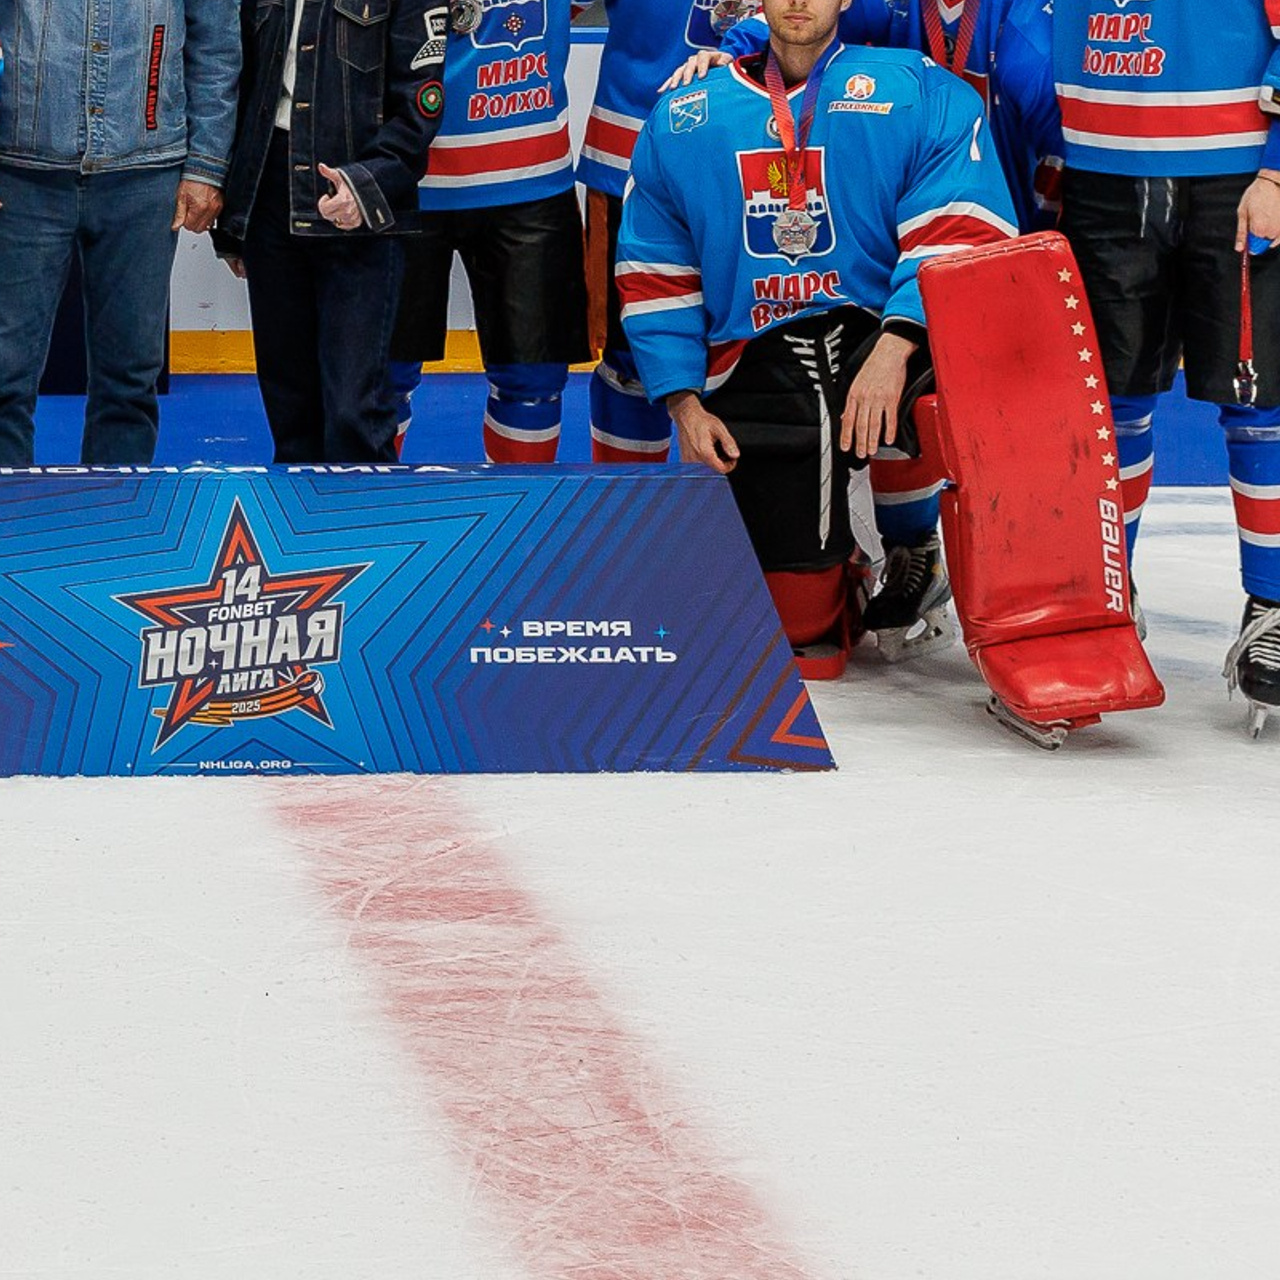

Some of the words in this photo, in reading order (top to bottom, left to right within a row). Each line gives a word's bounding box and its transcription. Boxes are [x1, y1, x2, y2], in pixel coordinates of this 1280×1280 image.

[1087, 12, 1154, 43] МАРС
[477, 51, 549, 90] МАРС
[753, 270, 848, 302] МАРС
[1098, 497, 1124, 614] BAUER
[222, 564, 262, 605] 14
[207, 600, 277, 623] FONBET
[522, 620, 632, 638] ВРЕМЯ
[145, 609, 338, 681] НОЧНАЯ
[469, 646, 678, 664] ПОБЕЖДАТЬ
[216, 668, 276, 695] ЛИГА
[231, 699, 262, 714] 2025
[198, 759, 293, 770] NHLIGA.ORG
